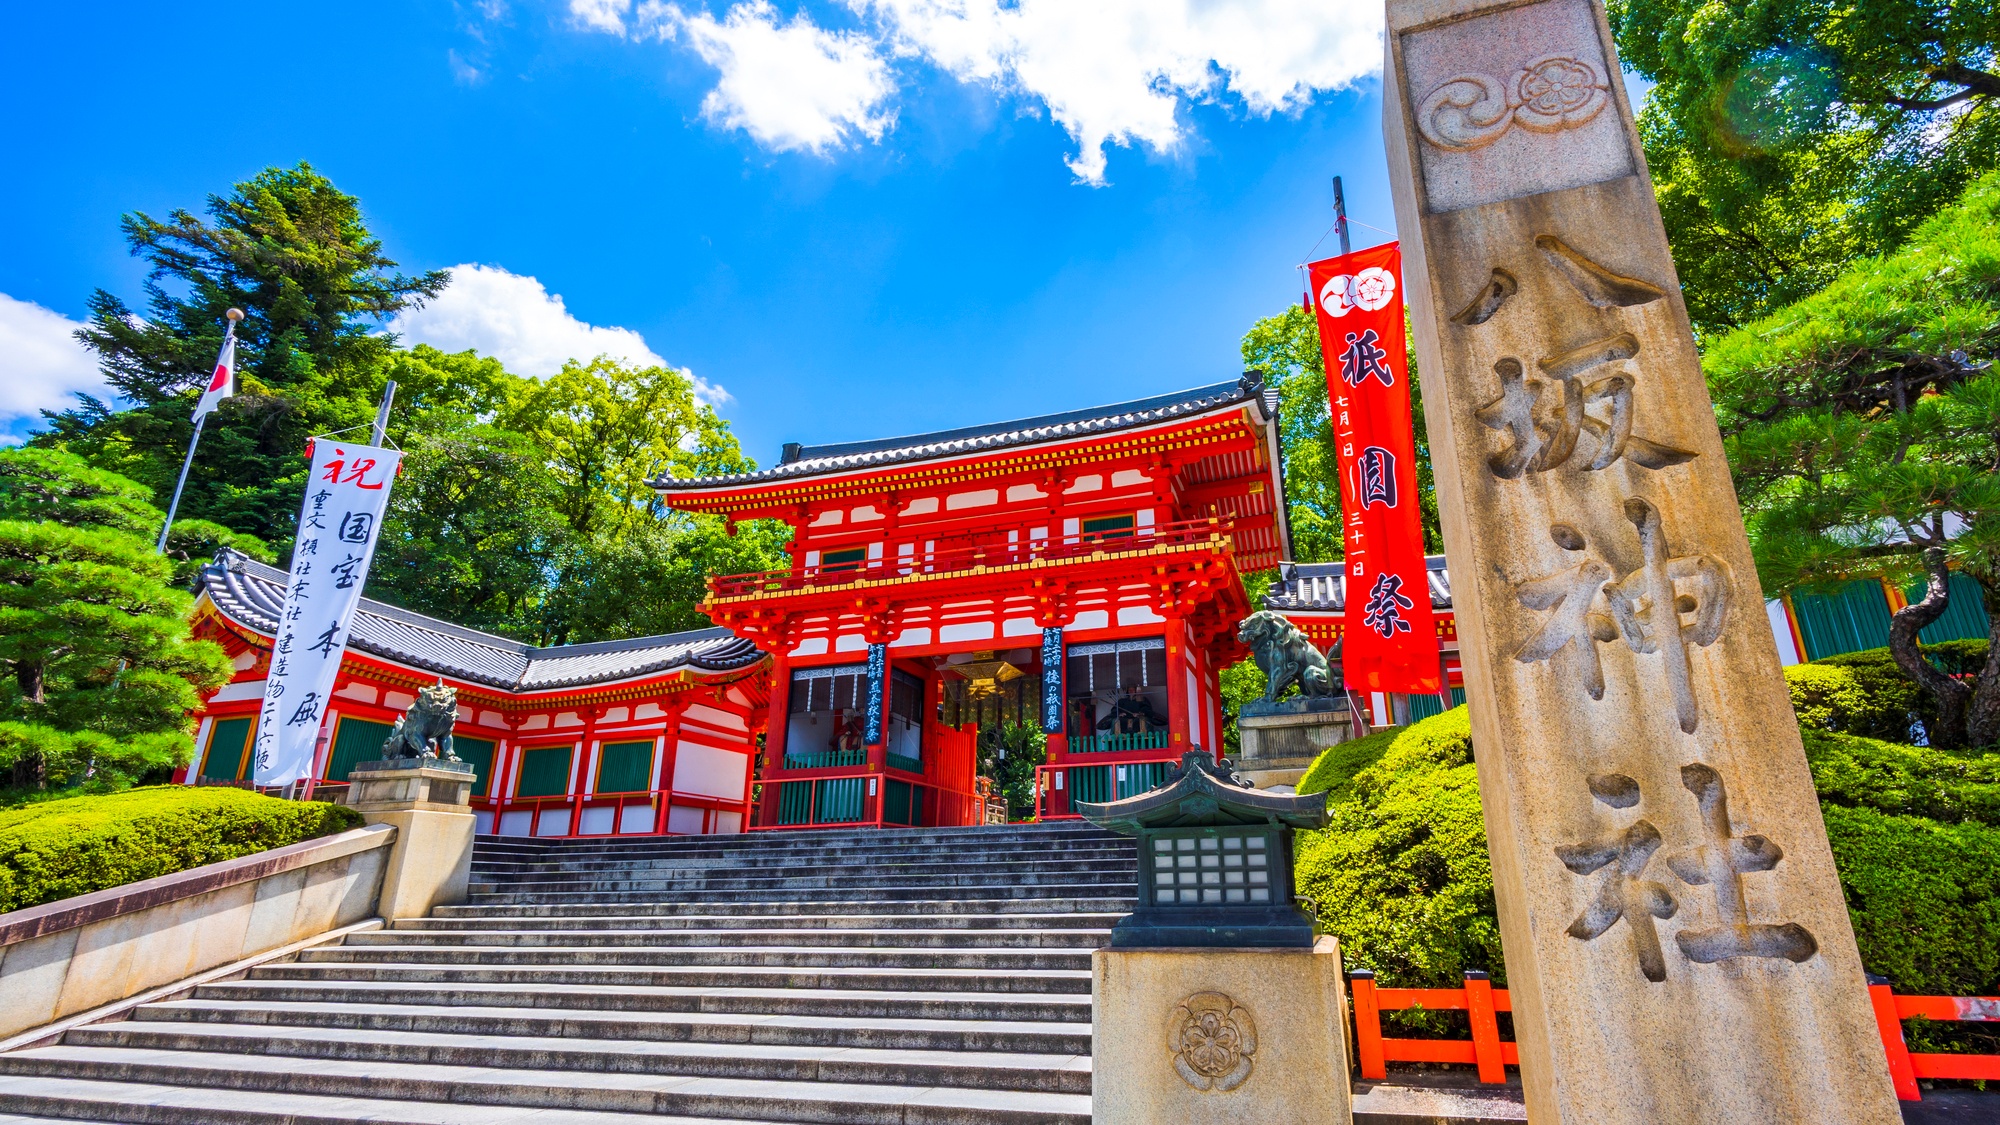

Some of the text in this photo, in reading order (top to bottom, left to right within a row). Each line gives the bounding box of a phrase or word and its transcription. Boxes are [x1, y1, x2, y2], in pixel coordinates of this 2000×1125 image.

[322, 448, 383, 490] 祝
[1339, 329, 1414, 638] 祇園祭
[1450, 234, 1818, 983] 八坂神社
